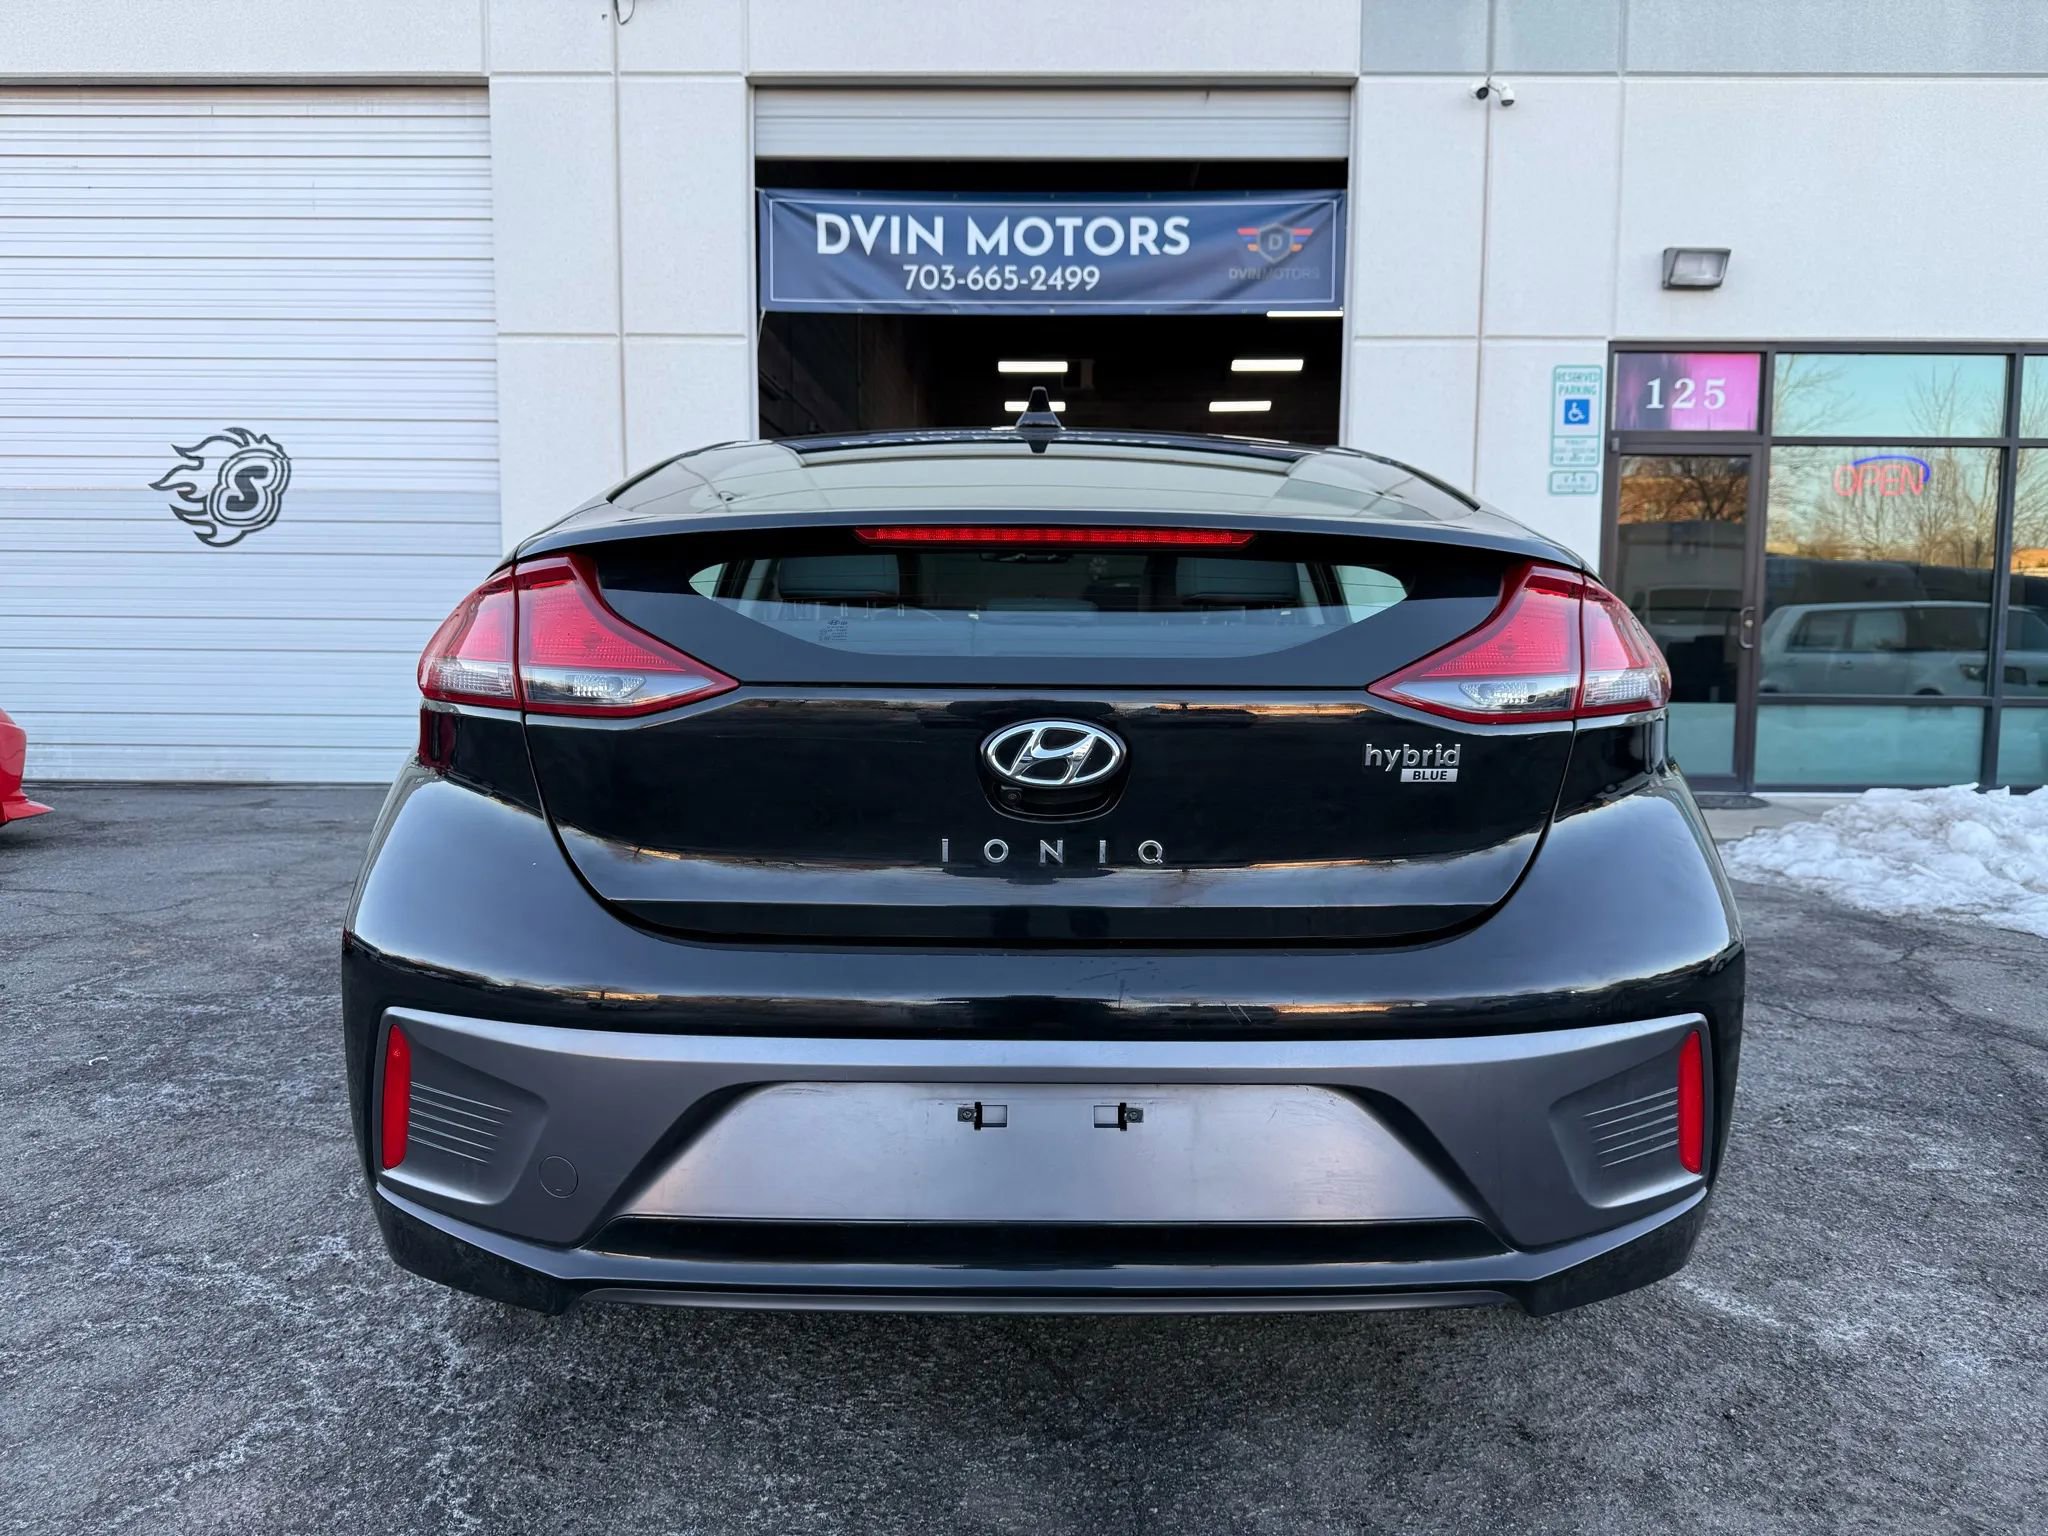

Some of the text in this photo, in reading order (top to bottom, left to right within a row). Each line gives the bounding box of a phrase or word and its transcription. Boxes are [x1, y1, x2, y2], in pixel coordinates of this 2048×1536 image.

[816, 213, 1191, 257] DVIN MOTORS
[903, 264, 1101, 292] 703-665-2499
[1558, 384, 1597, 396] PARKING
[1645, 377, 1727, 410] 125
[1833, 463, 1926, 497] OPEN
[1364, 743, 1461, 772] hybrid
[1412, 770, 1448, 781] BLUE
[941, 838, 1164, 865] IONIQ
